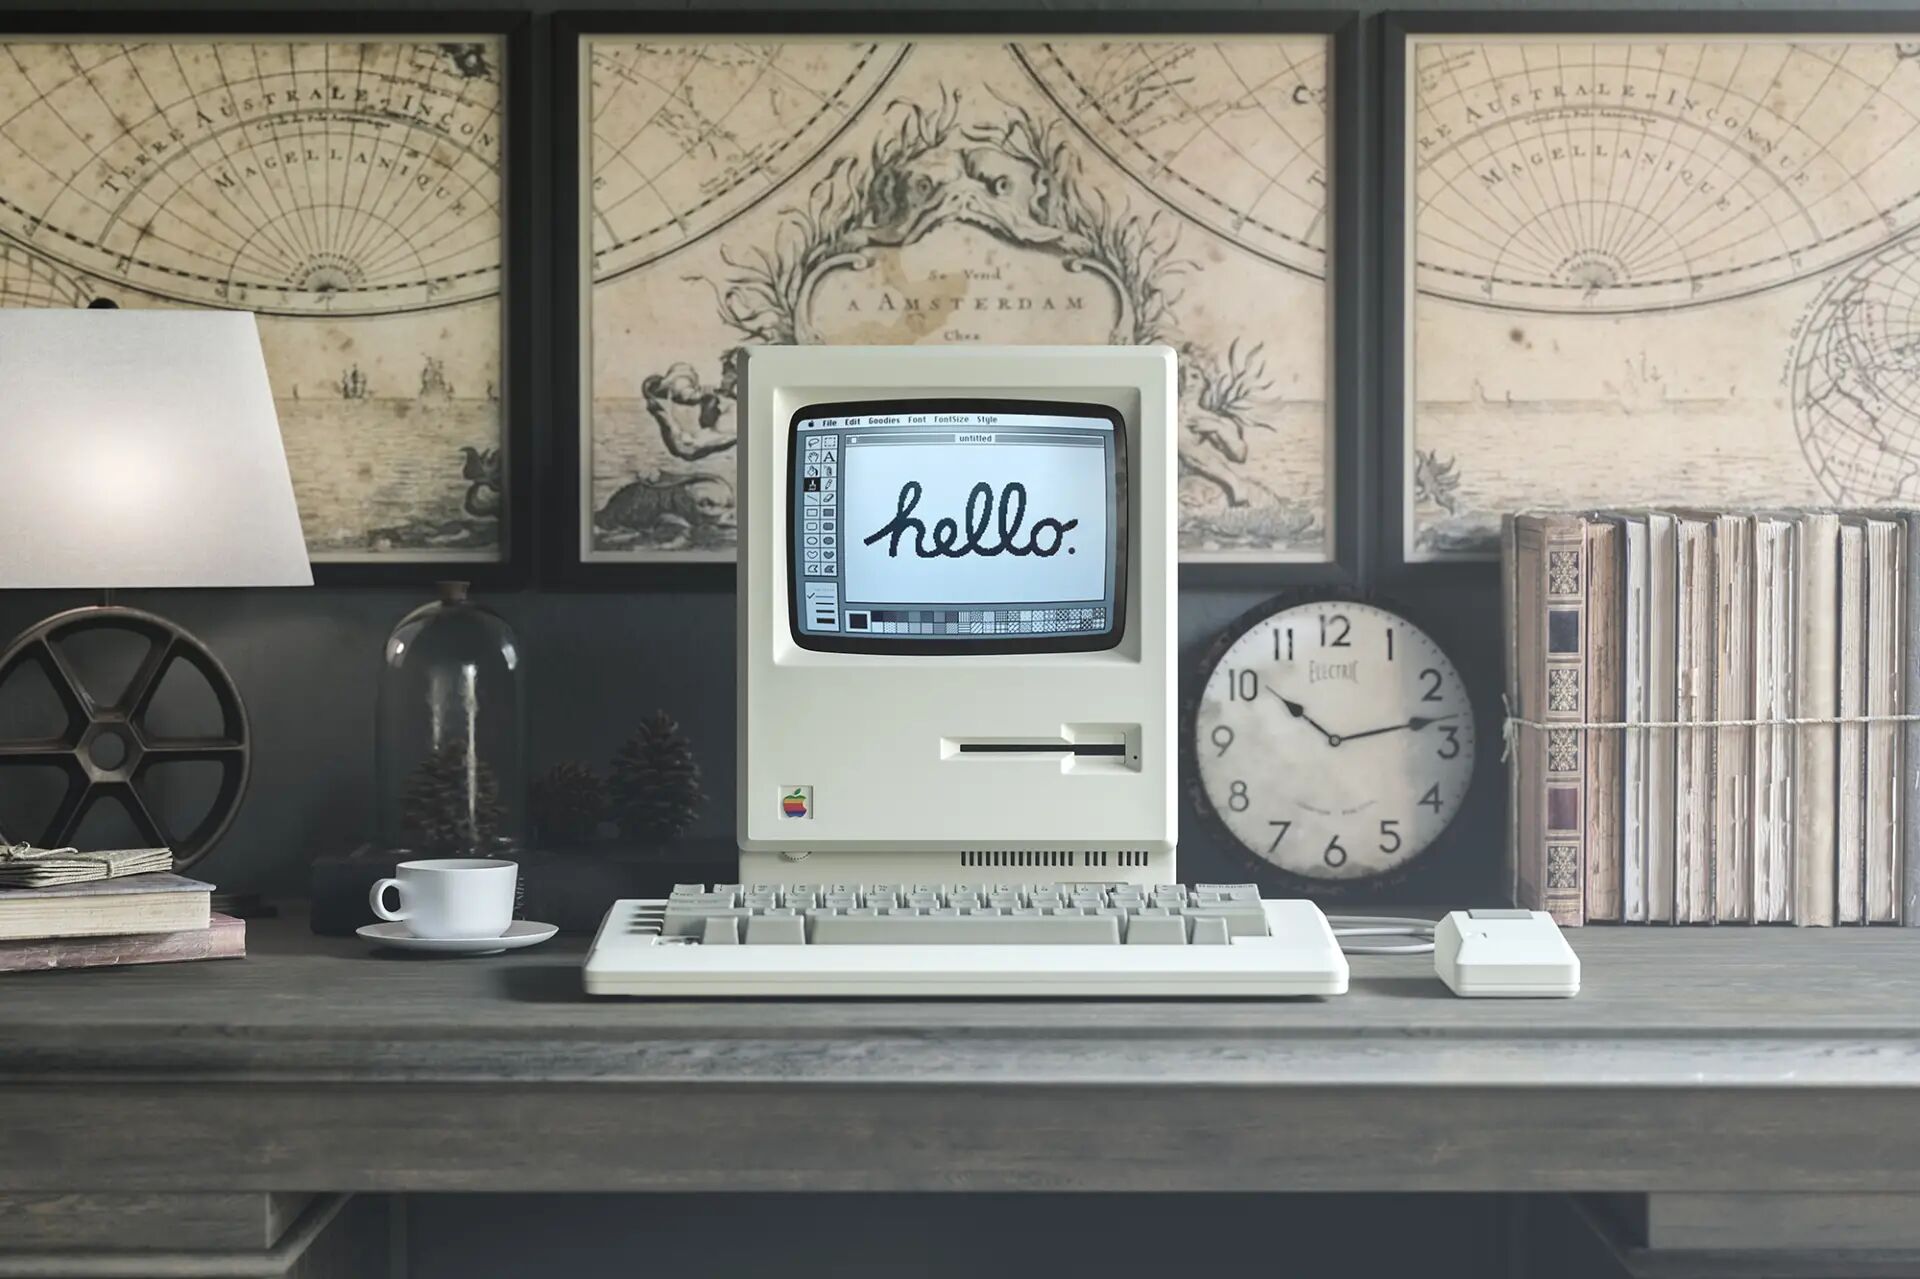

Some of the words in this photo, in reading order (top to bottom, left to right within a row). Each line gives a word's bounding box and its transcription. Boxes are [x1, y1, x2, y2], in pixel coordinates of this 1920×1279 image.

[101, 128, 187, 196] TERRE
[196, 84, 370, 128] AUSTRALE
[1464, 81, 1637, 124] AUSTRALE
[1667, 87, 1811, 187] INCONNUE
[213, 148, 470, 218] MAGELLANIQUE
[1480, 143, 1731, 212] MAGELLANIQUE
[877, 292, 1085, 312] AMSTERDAM
[822, 419, 838, 427] File
[844, 417, 861, 426] Edit
[868, 415, 901, 425] Goodies
[907, 415, 927, 424] Font
[933, 414, 970, 424] FontSize
[976, 414, 998, 425] Style
[958, 433, 993, 444] untitled
[863, 481, 1078, 558] hello.
[1273, 628, 1293, 661] 11
[1319, 614, 1351, 647] 12
[1386, 628, 1394, 661] 1
[1228, 668, 1258, 701] 10
[1419, 668, 1443, 701] 2
[1211, 725, 1234, 757] 9
[1436, 725, 1460, 760] 3
[1228, 780, 1249, 812] 8
[1417, 781, 1444, 814] 4
[1267, 821, 1292, 852] 7
[1323, 834, 1347, 867] 6
[1378, 820, 1402, 853] 5
